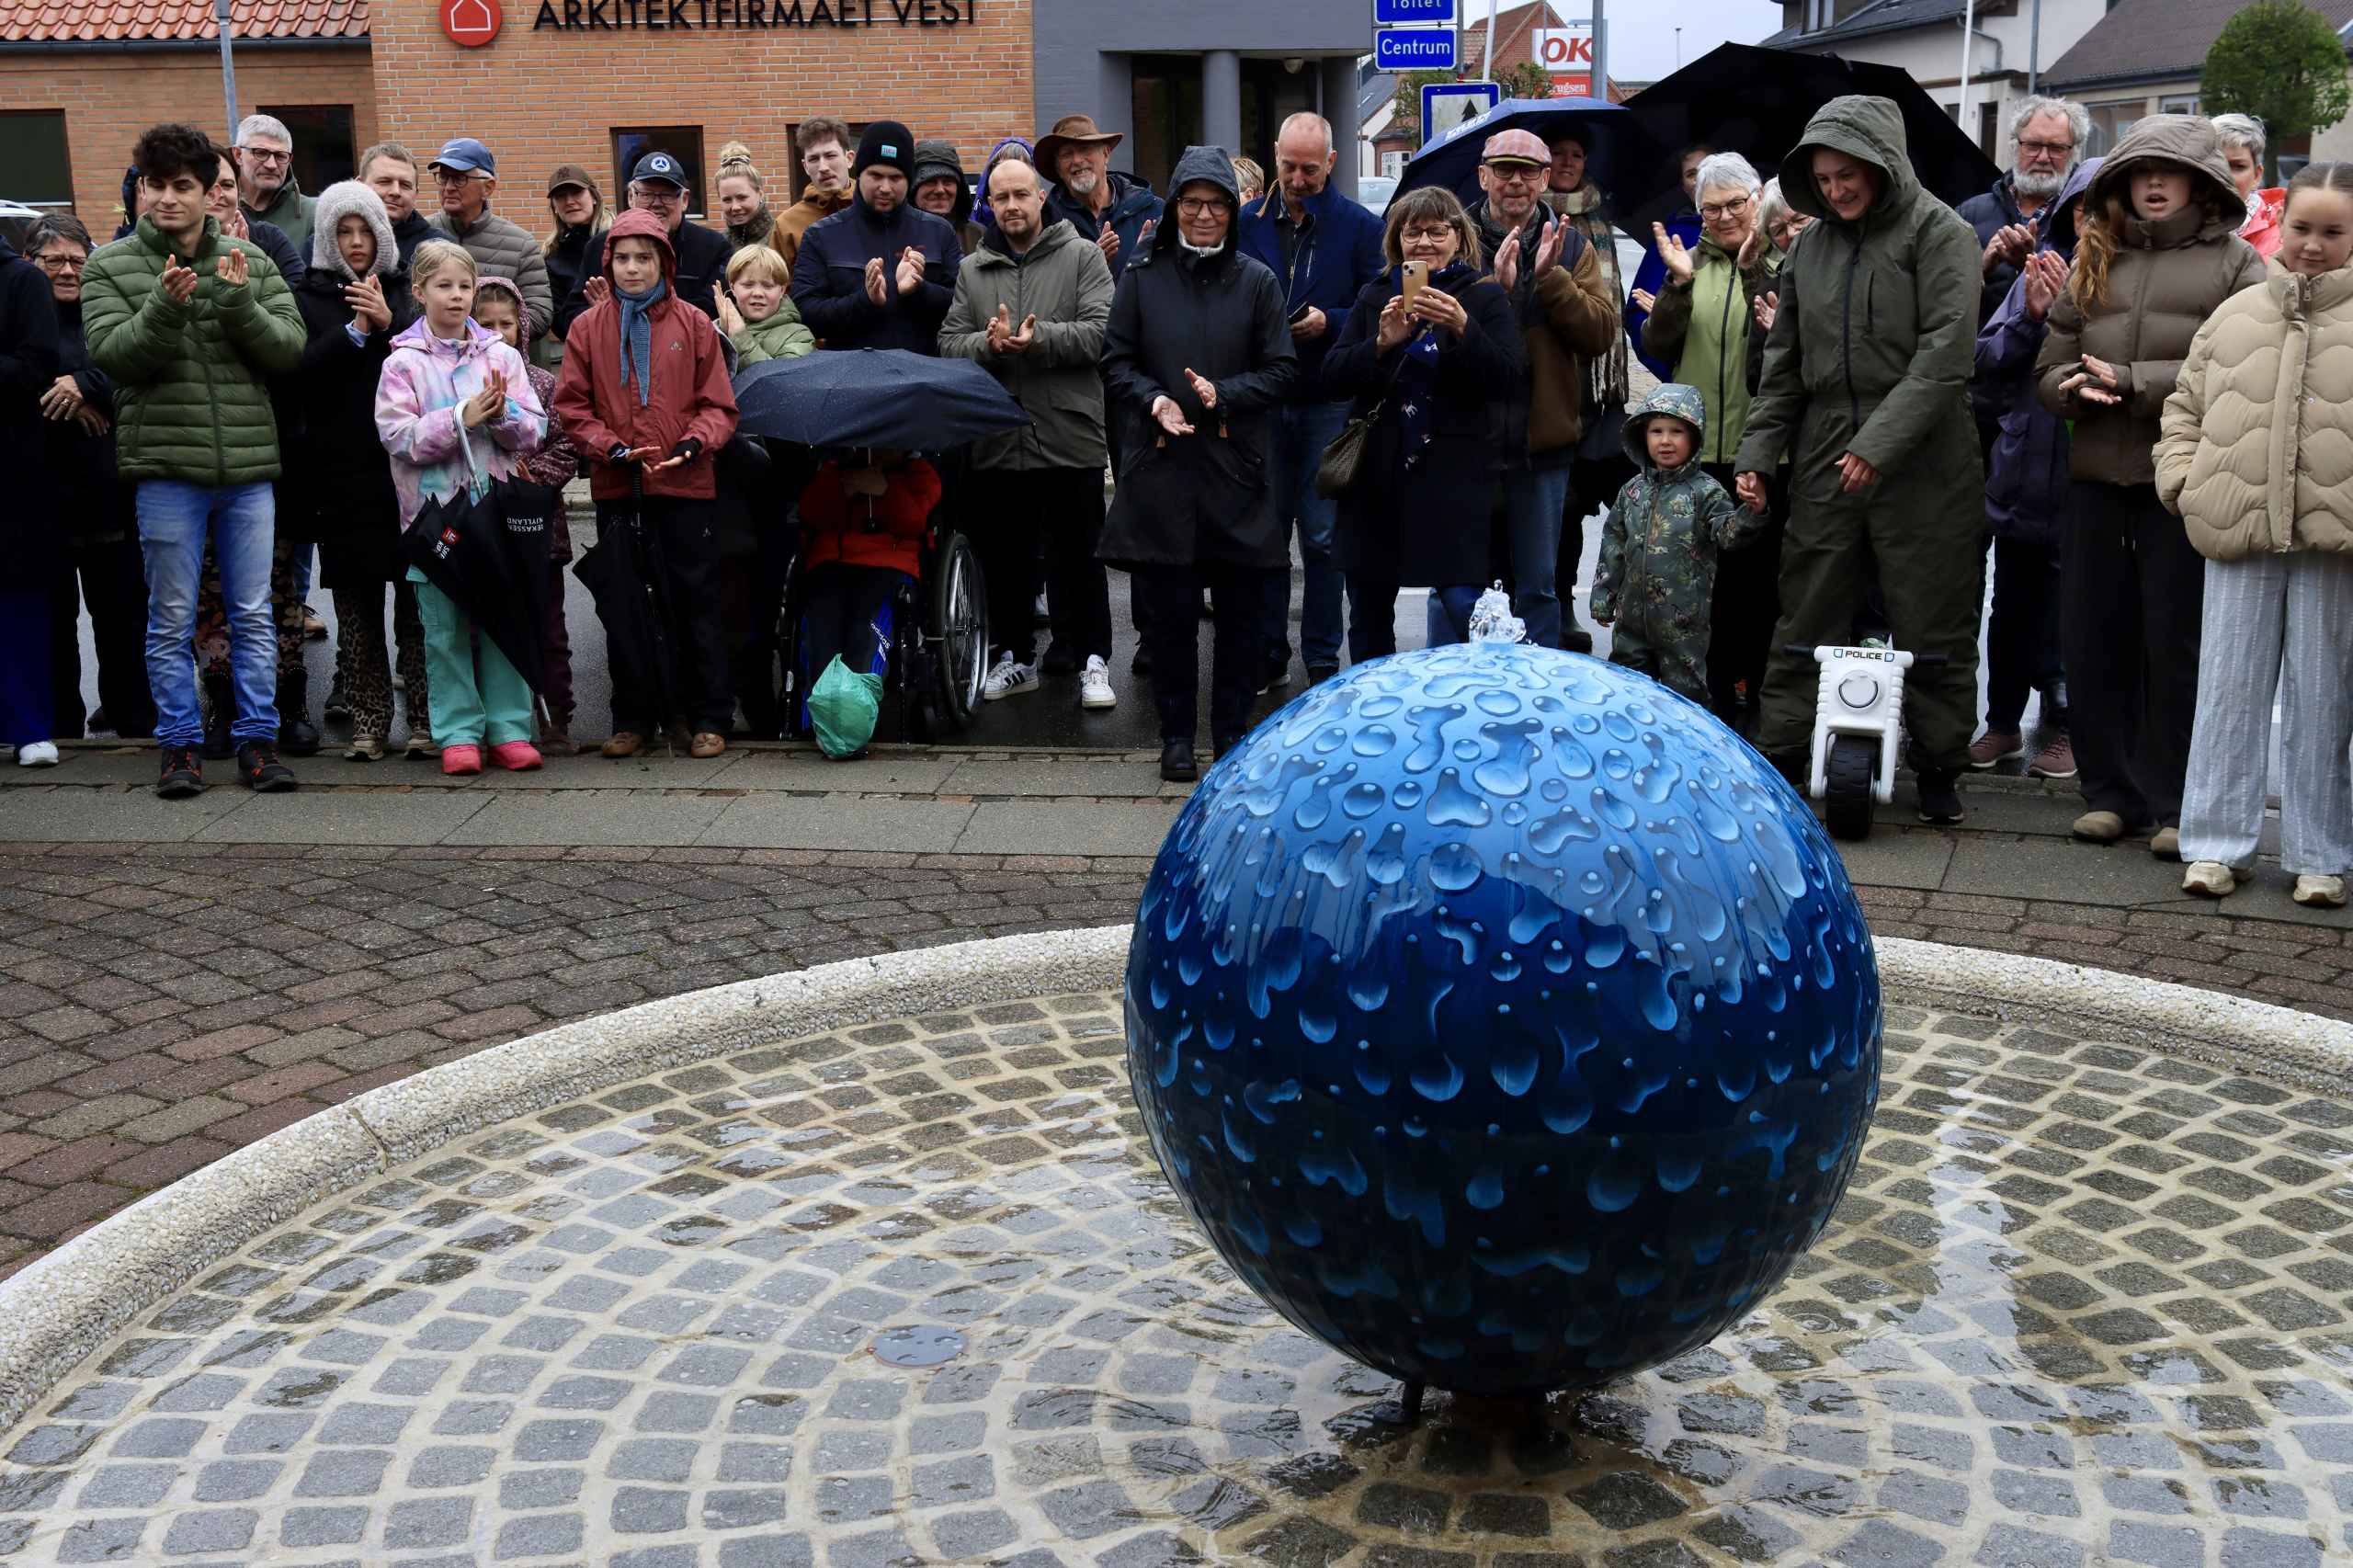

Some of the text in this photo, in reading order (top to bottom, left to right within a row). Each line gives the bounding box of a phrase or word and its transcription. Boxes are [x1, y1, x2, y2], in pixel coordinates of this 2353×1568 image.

[1381, 38, 1450, 55] Centrum
[1540, 37, 1593, 62] OK
[1846, 650, 1883, 660] POLICE
